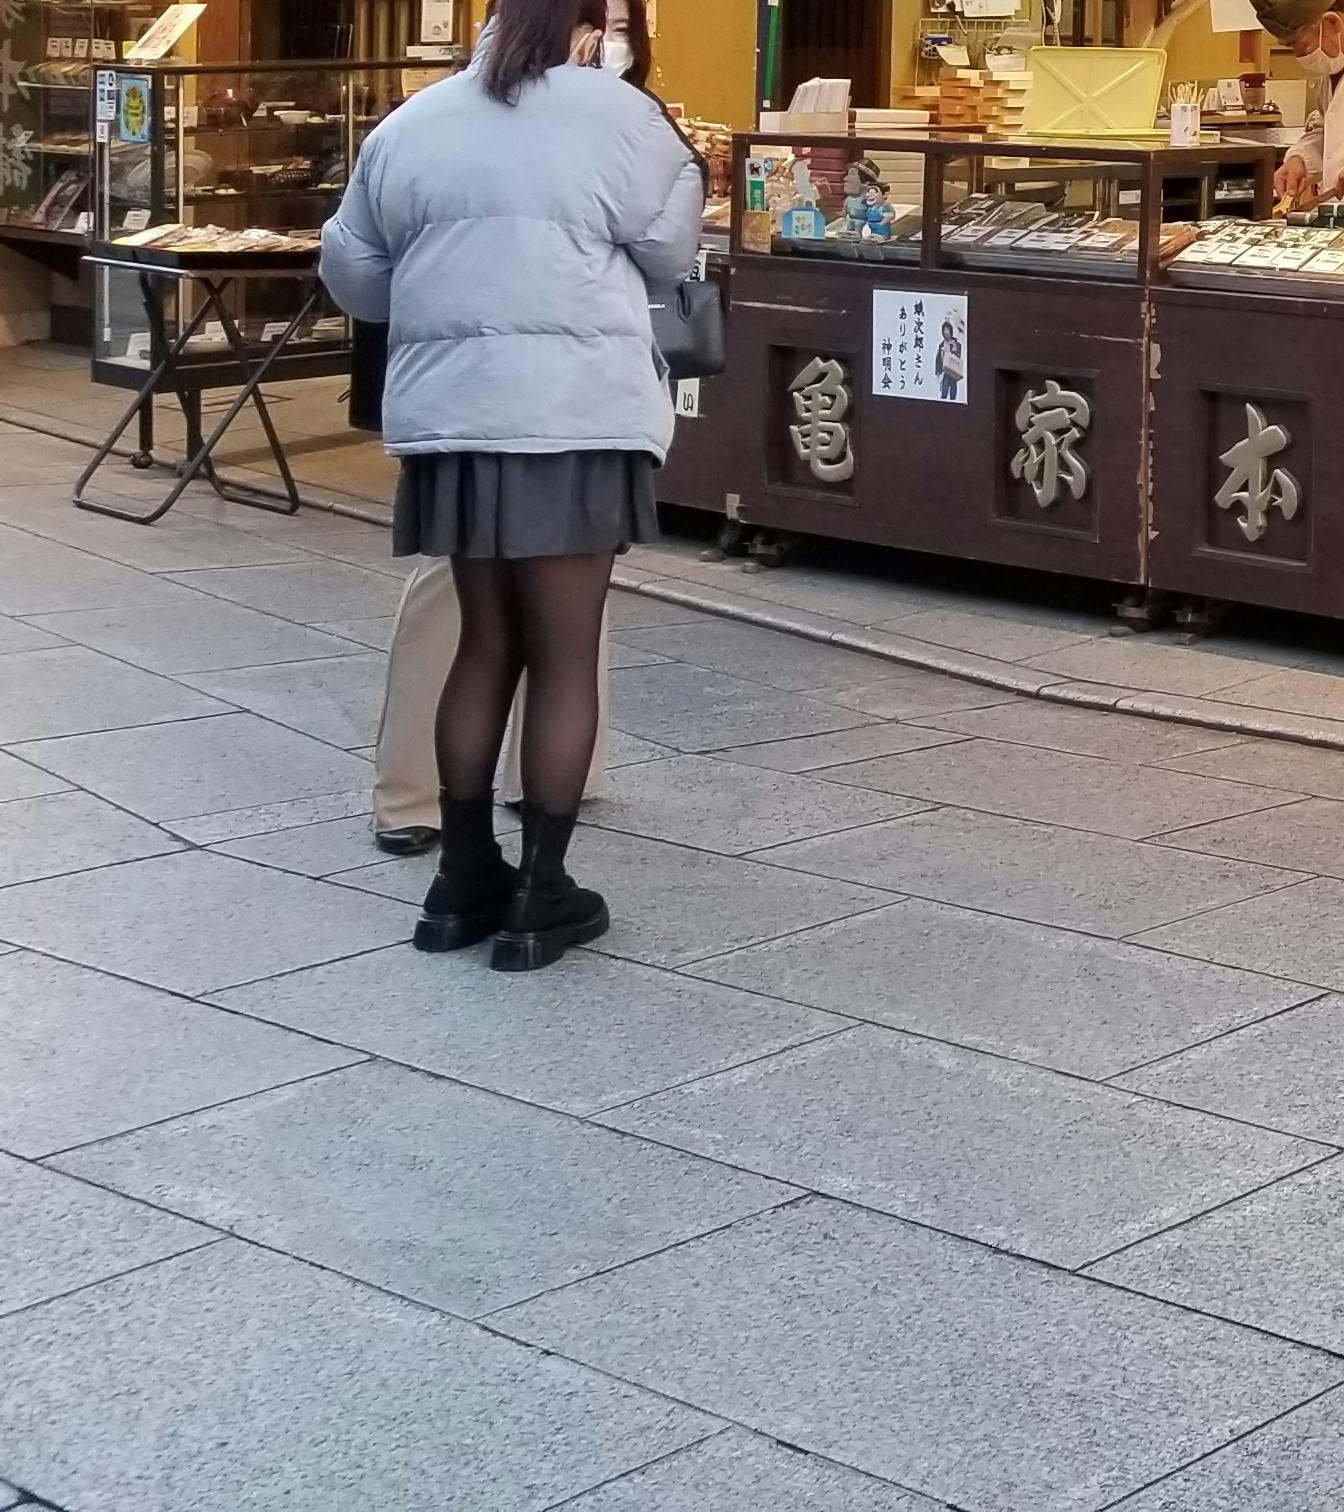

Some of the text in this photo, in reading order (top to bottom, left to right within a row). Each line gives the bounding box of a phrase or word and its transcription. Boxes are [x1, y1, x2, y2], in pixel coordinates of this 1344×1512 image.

[881, 337, 893, 390] 神明会
[898, 305, 908, 390] ありがとう
